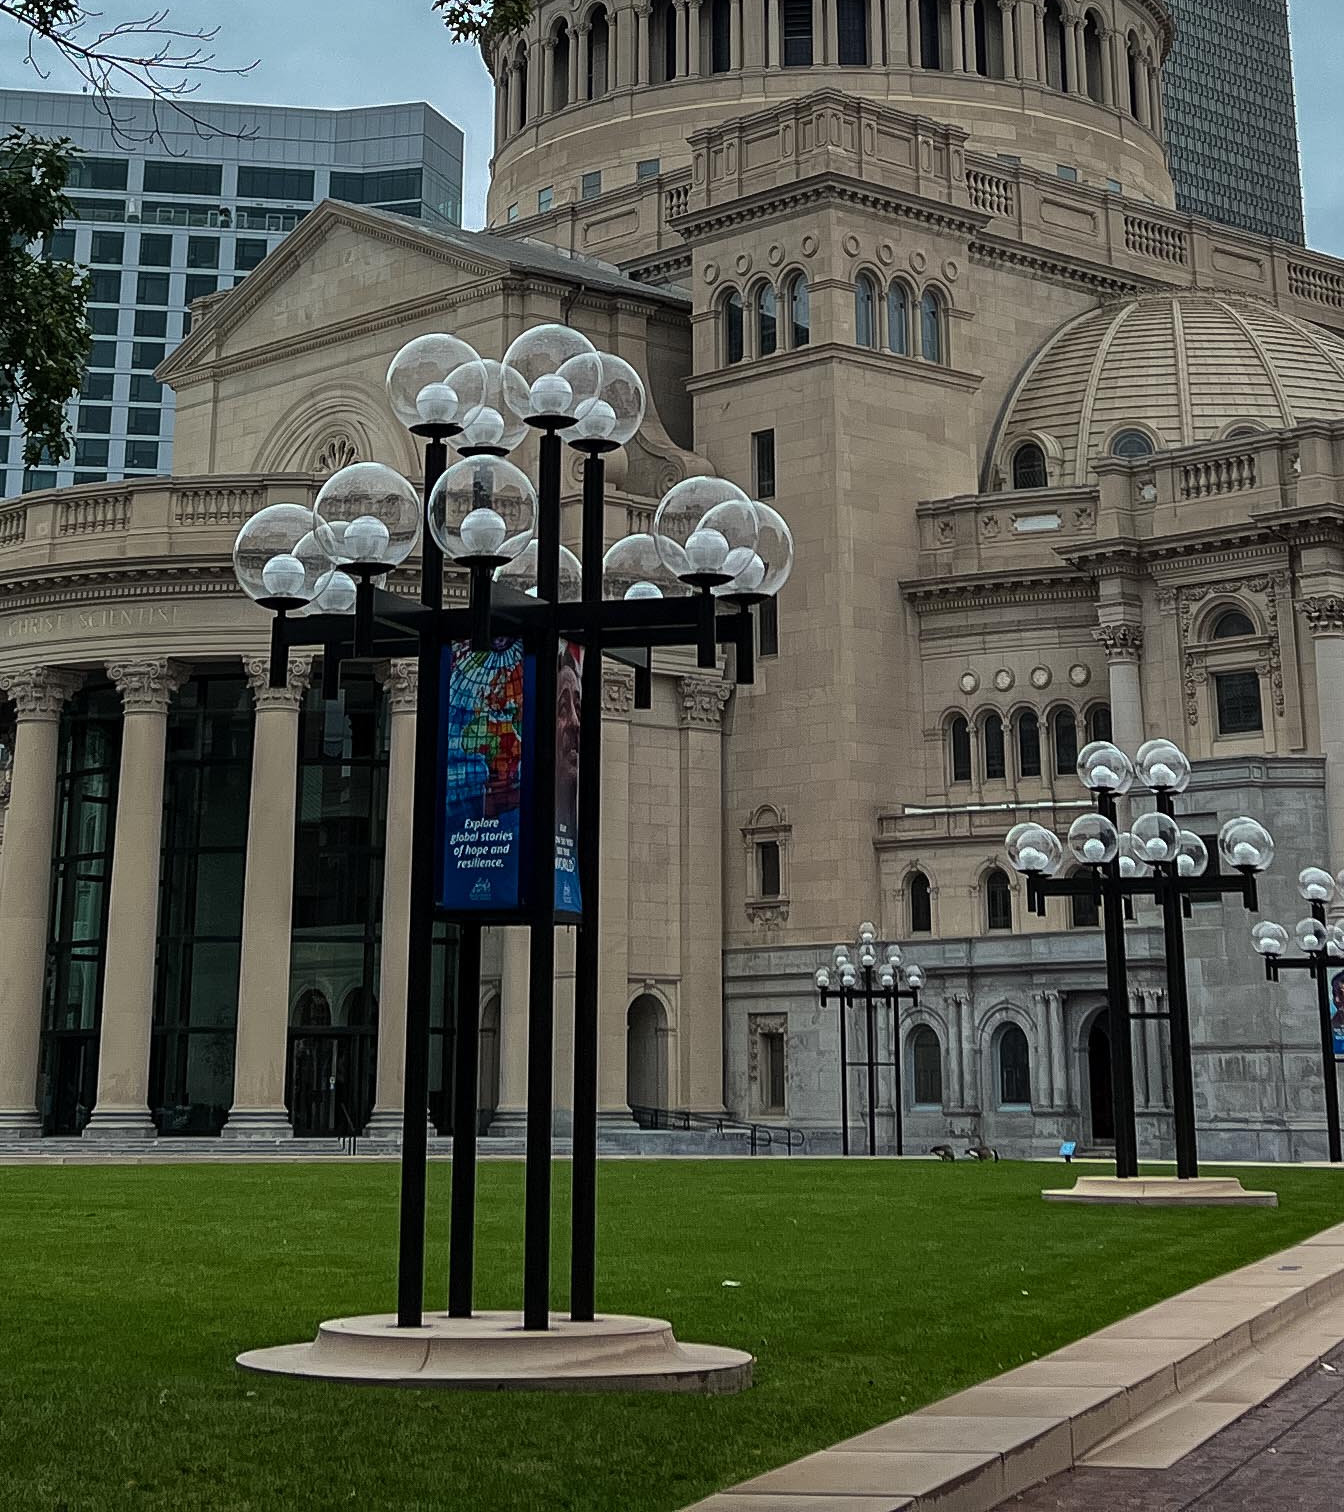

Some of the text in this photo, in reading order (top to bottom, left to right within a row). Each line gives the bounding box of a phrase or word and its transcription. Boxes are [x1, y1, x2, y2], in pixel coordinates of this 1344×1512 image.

[9, 613, 64, 637] CHRIST
[79, 606, 180, 629] SCIENTIST
[464, 817, 500, 831] Explore
[449, 830, 513, 845] global stories
[453, 843, 510, 858] of hope and
[457, 858, 505, 869] resilience.
